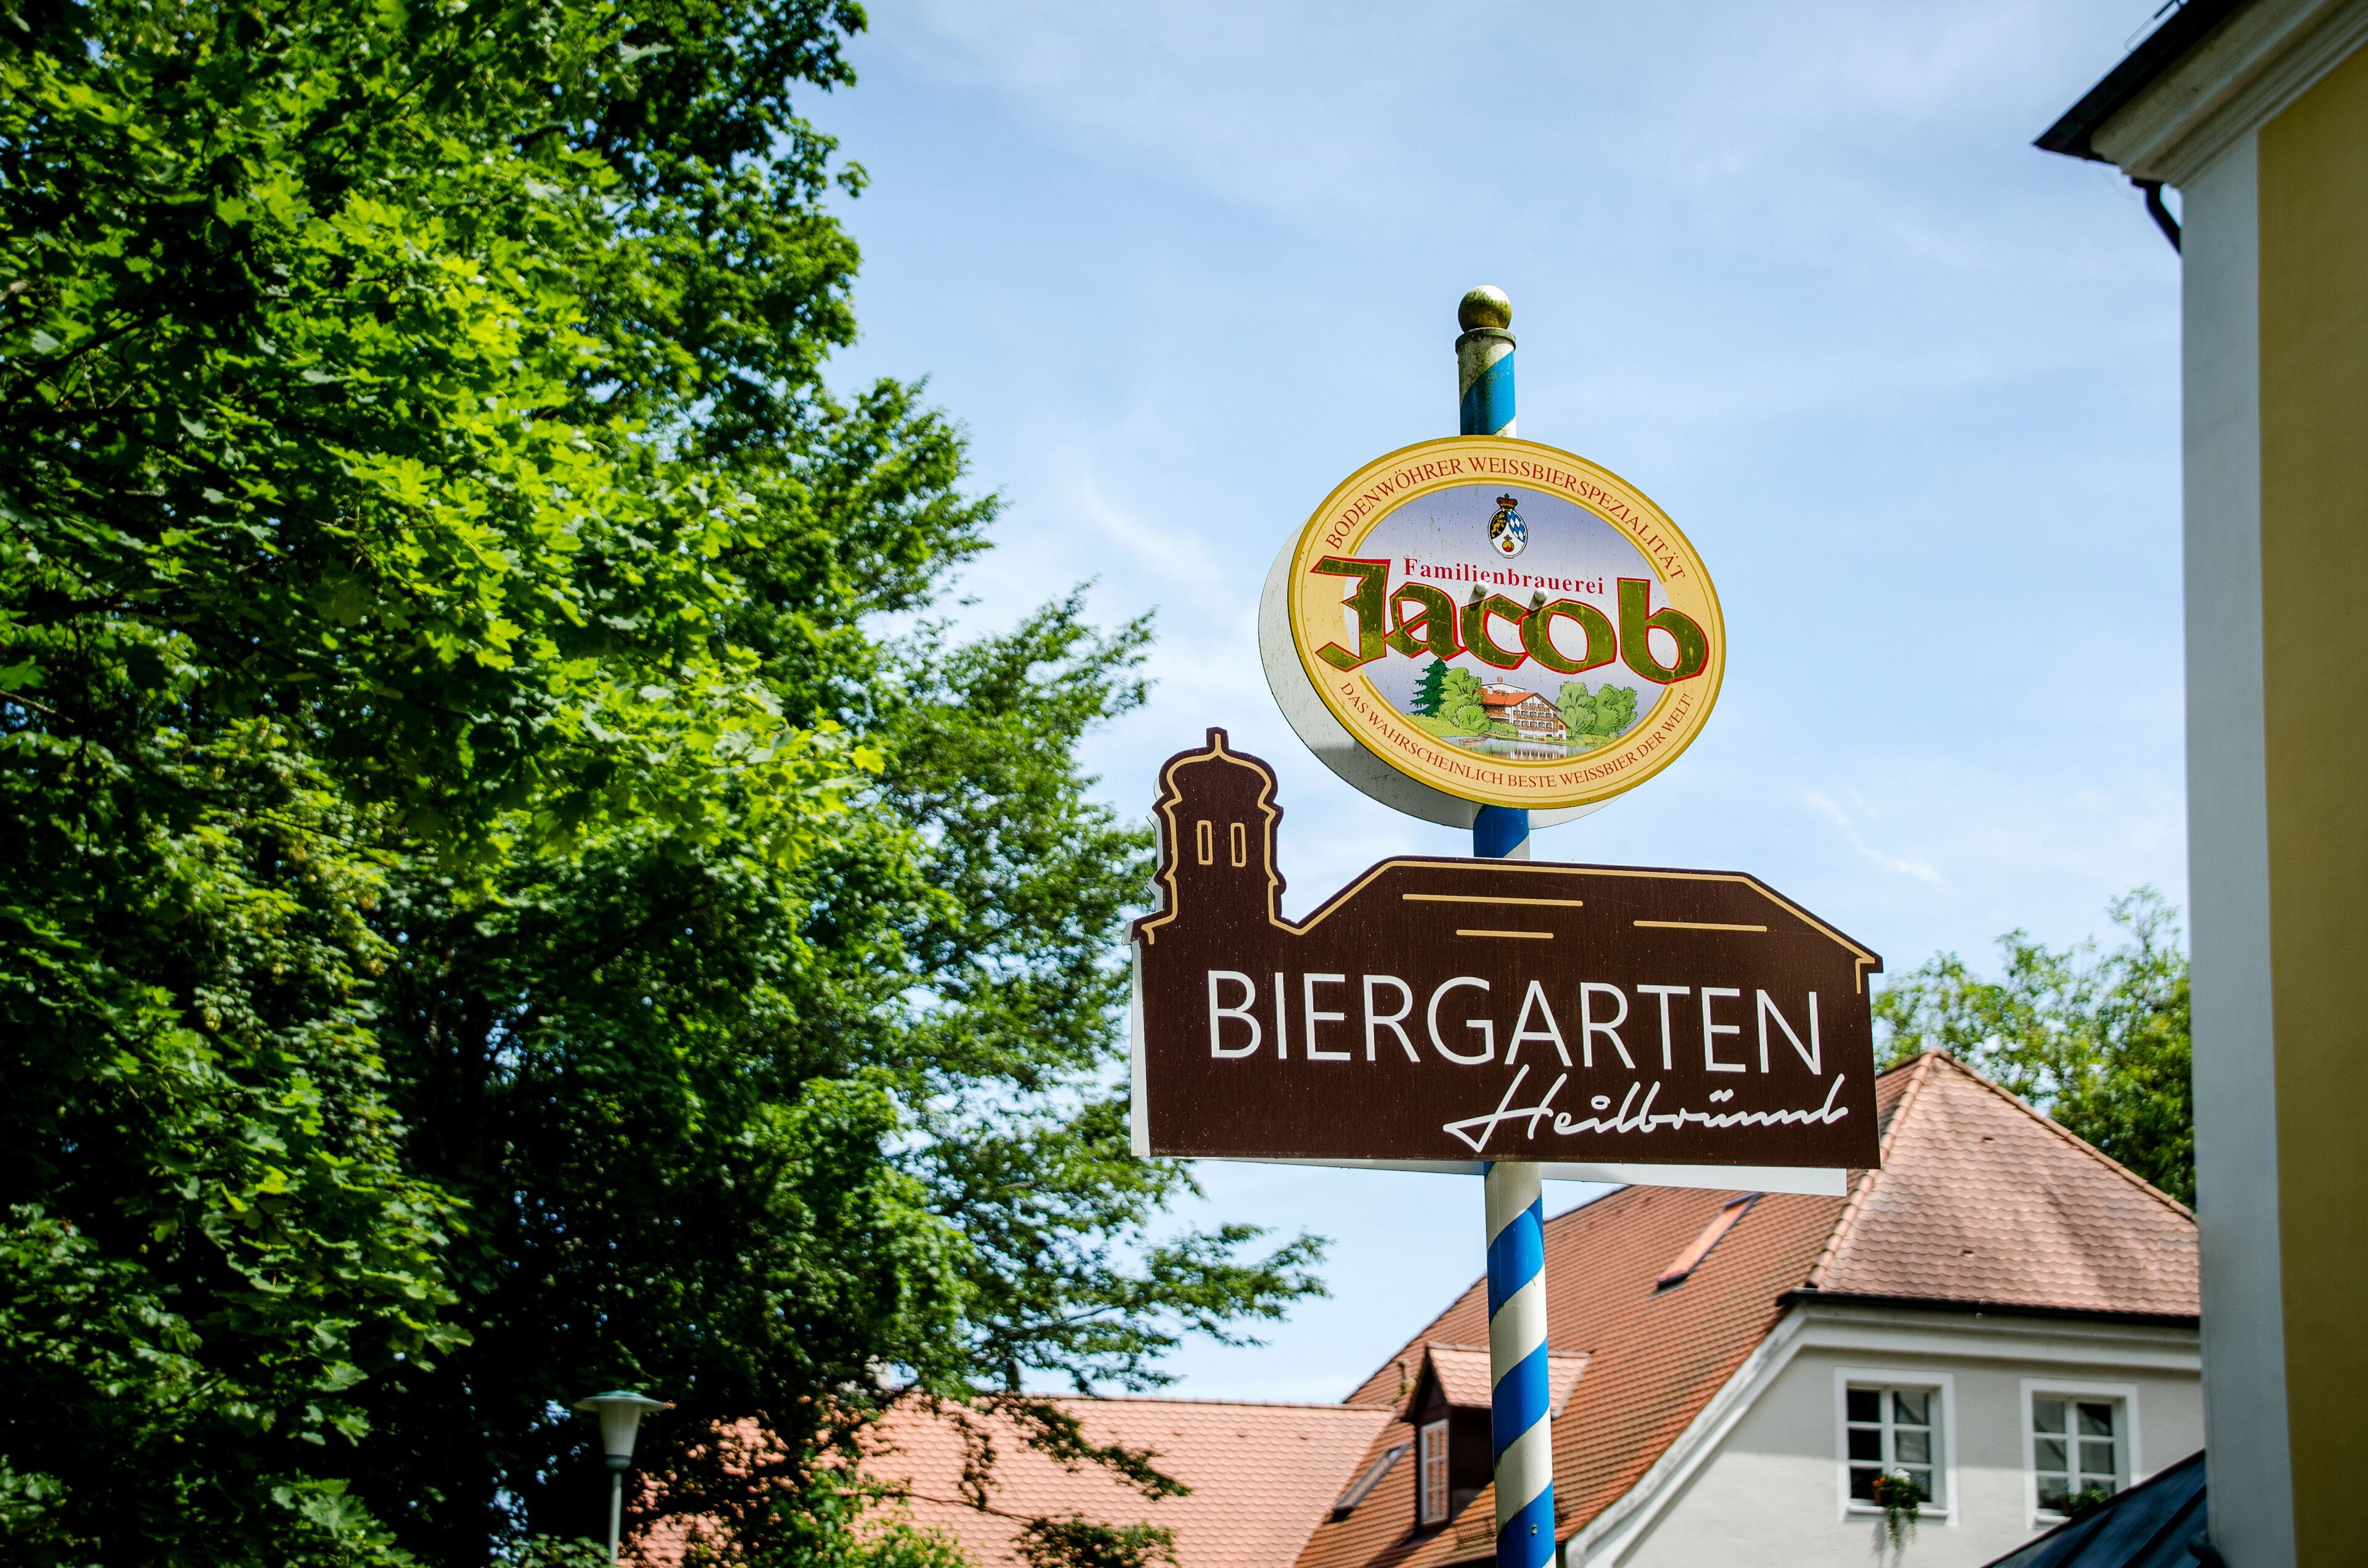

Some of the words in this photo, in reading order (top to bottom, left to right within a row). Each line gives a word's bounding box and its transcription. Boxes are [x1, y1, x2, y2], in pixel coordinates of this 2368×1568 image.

[1325, 458, 1463, 550] BODENWÖHRER
[1468, 456, 1685, 580] WEISSBIERSPEZIALITÄT
[1310, 555, 1709, 684] Jacob
[1404, 558, 1604, 594] Familienbrauerei
[1341, 682, 1368, 713] DAS
[1368, 712, 1503, 785] WAHRSCHEINLICH
[1508, 774, 1556, 787] BESTE
[1560, 752, 1638, 785] WEISSBIER
[1635, 731, 1666, 758] DER
[1661, 693, 1694, 733] WELT!
[1207, 970, 1822, 1075] BIERGARTEN
[1443, 1065, 1848, 1153] Heilbrünnl
